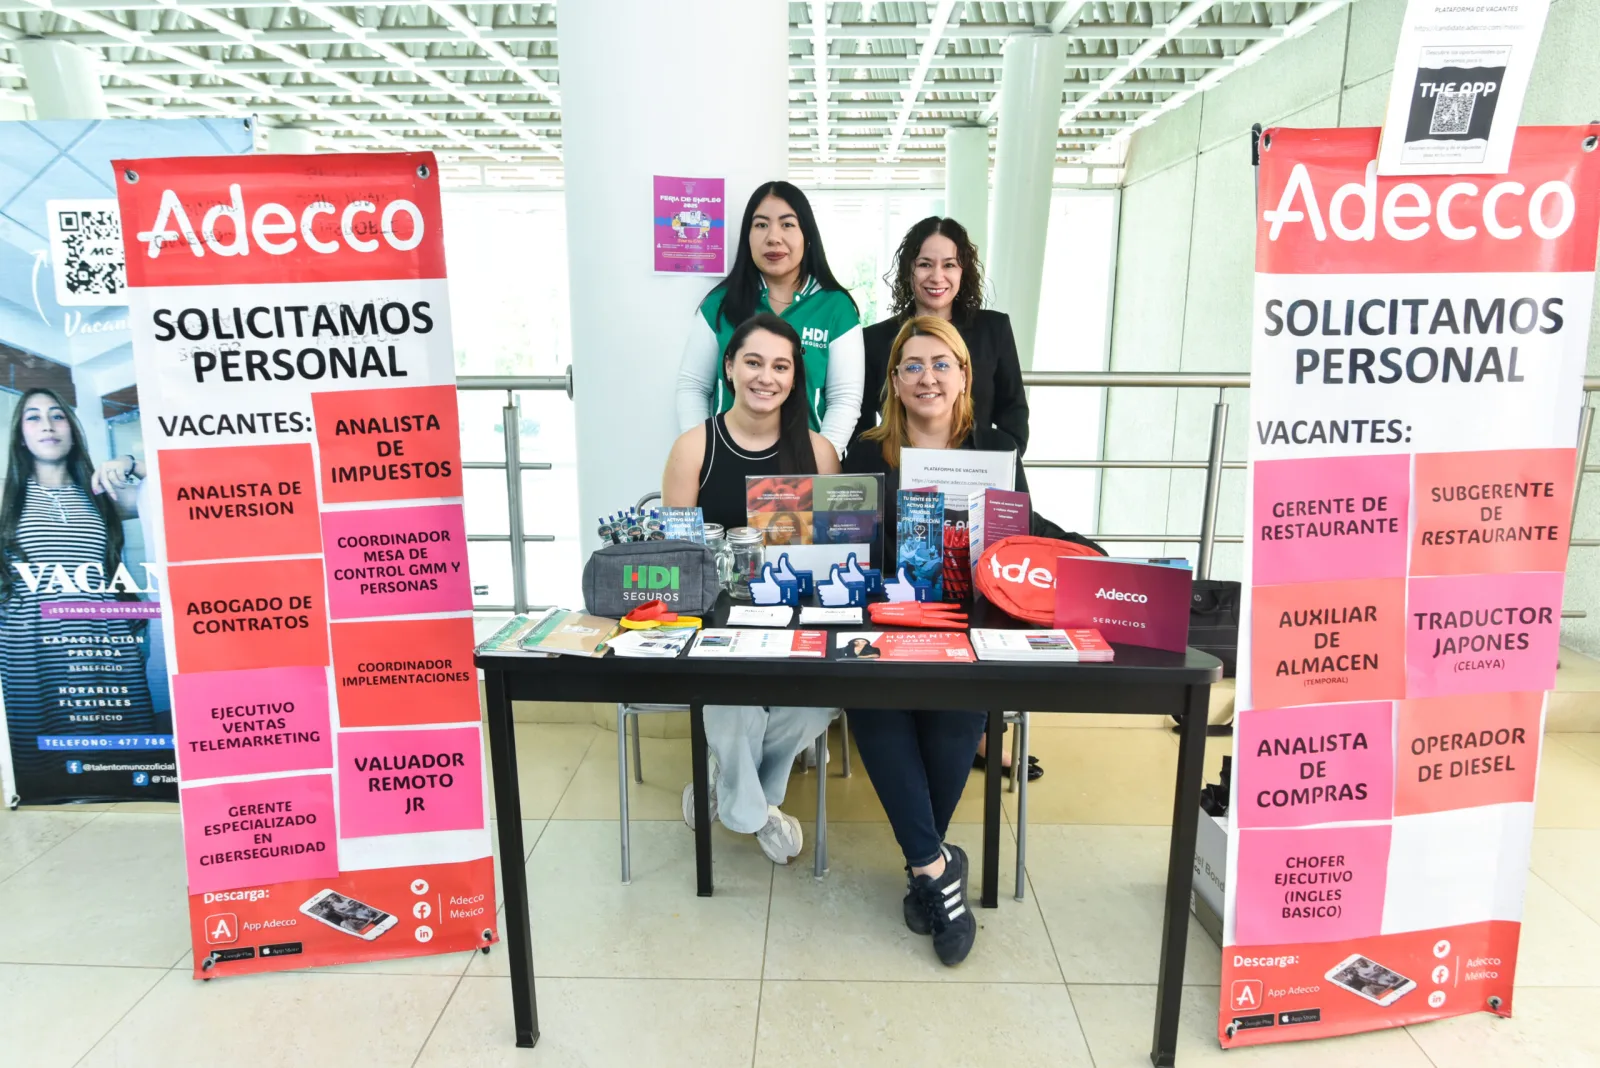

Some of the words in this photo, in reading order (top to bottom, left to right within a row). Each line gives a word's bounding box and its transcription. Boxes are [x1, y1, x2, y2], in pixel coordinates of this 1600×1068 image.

[1420, 82, 1456, 98] THE
[1459, 82, 1496, 97] APP
[1263, 159, 1576, 242] Adecco
[137, 183, 425, 258] Adecco
[153, 301, 434, 341] SOLICITAMOS
[1264, 298, 1564, 336] SOLICITAMOS
[801, 340, 827, 348] SEGUROS
[802, 326, 828, 342] HDI
[194, 345, 408, 383] PERSONAL
[1296, 346, 1525, 384] PERSONAL
[157, 411, 312, 437] VACANTES:
[335, 414, 441, 436] ANALISTA
[1257, 419, 1412, 445] VACANTES:
[376, 439, 405, 457] DE
[331, 460, 452, 484] IMPUESTOS
[177, 482, 273, 501] ANALISTA
[278, 481, 302, 496] DE
[1431, 482, 1554, 503] SUBGERENTE
[189, 500, 294, 521] INVERSION
[1272, 497, 1355, 518] GERENTE
[1362, 496, 1388, 513] DE
[1480, 505, 1503, 522] DE
[1261, 517, 1399, 541] RESTAURANTE
[1421, 525, 1559, 546] RESTAURANTE
[337, 530, 451, 549] COORDINADOR
[363, 549, 405, 563] MESA
[408, 547, 429, 560] DE
[12, 562, 159, 594] VACAN
[334, 565, 406, 581] CONTROL
[408, 562, 444, 576] GMM
[447, 561, 460, 574] Y
[623, 564, 680, 590] HDI
[988, 554, 1056, 589] Ade
[360, 578, 438, 595] PERSONAS
[623, 591, 679, 602] SEGUROS
[1095, 588, 1148, 604] Adecco
[186, 597, 283, 616] ABOGADO
[289, 595, 313, 610] DE
[192, 615, 309, 635] CONTRATOS
[1093, 617, 1146, 628] SERVICIOS
[1279, 605, 1377, 629] AUXILIAR
[1413, 606, 1553, 631] TRADUCTOR
[43, 635, 144, 644] CAPACITACIÓN
[1314, 631, 1340, 650] DE
[1432, 632, 1529, 659] JAPONES
[357, 659, 453, 673] COORDINADOR
[1276, 653, 1378, 677] ALMACEN
[1453, 658, 1505, 673] (CELAYA)
[342, 671, 470, 687] IMPLEMENTACIONES
[1303, 676, 1349, 686] (TEMPORAL)
[211, 701, 295, 721] EJECUTIVO
[222, 717, 286, 734] VENTAS
[188, 730, 321, 753] TELEMARKETING
[1256, 732, 1368, 757] ANALISTA
[1411, 727, 1526, 756] OPERADOR
[82, 763, 175, 772] @talentomunozoficial
[354, 752, 465, 772] VALUADOR
[1300, 760, 1326, 780] DE
[1418, 763, 1443, 783] DE
[1449, 754, 1516, 778] DIESEL
[368, 773, 454, 793] REMOTO
[1256, 782, 1368, 808] COMPRAS
[228, 800, 292, 818] GERENTE
[404, 796, 426, 815] JR
[204, 813, 317, 837] ESPECIALIZADO
[253, 833, 273, 845] EN
[199, 841, 326, 866] CIBERSEGURIDAD
[1285, 855, 1345, 869] CHOFER
[1274, 870, 1353, 887] EJECUTIVO
[204, 889, 270, 904] Descarga:
[450, 894, 484, 905] Adecco
[1284, 889, 1342, 905] (INGLES
[450, 907, 484, 918] México
[1281, 903, 1342, 920] BASICO)
[243, 922, 261, 930] App
[264, 919, 296, 928] Adecco
[1234, 955, 1299, 968] Descarga:
[1466, 958, 1501, 968] Adecco
[1465, 971, 1498, 982] México
[1268, 988, 1286, 997] App
[1288, 986, 1320, 995] Adecco
